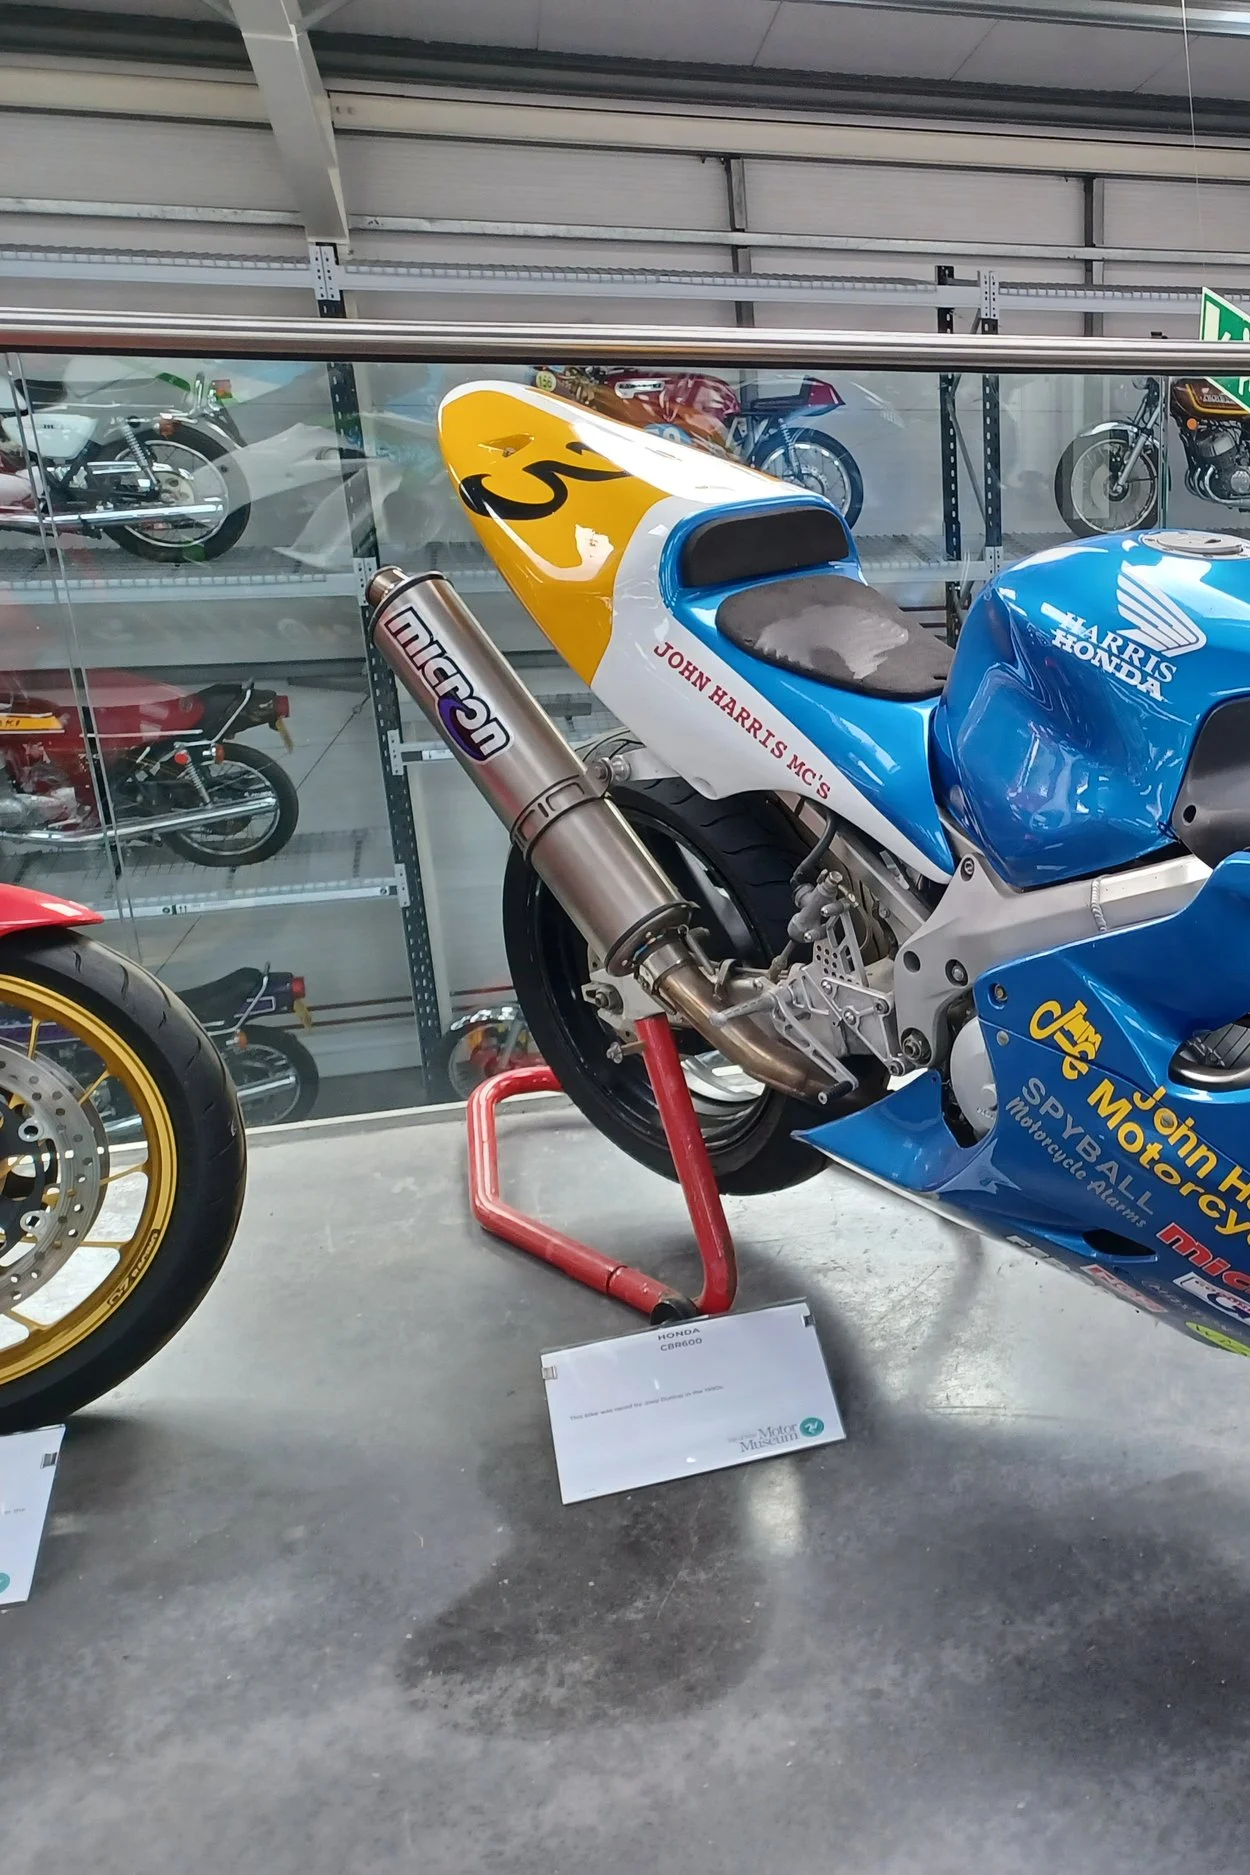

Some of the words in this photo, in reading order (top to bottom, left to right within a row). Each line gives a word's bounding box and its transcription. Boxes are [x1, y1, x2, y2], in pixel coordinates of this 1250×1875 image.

[384, 606, 510, 761] micron
[1051, 628, 1165, 702] HONDA
[1059, 612, 1177, 683] HARRIS
[653, 642, 711, 692] JOHN
[708, 685, 788, 759] HARRIS
[786, 753, 831, 799] MC'S
[1005, 1096, 1087, 1181] Motorcycle
[1087, 1171, 1147, 1229] Alarms
[1022, 1077, 1154, 1216] SPYBALL
[1133, 1085, 1217, 1177] John
[657, 1327, 701, 1341] HONDA
[660, 1337, 703, 1352] CBR600
[740, 1433, 799, 1453] Museum
[758, 1422, 798, 1441] Motor
